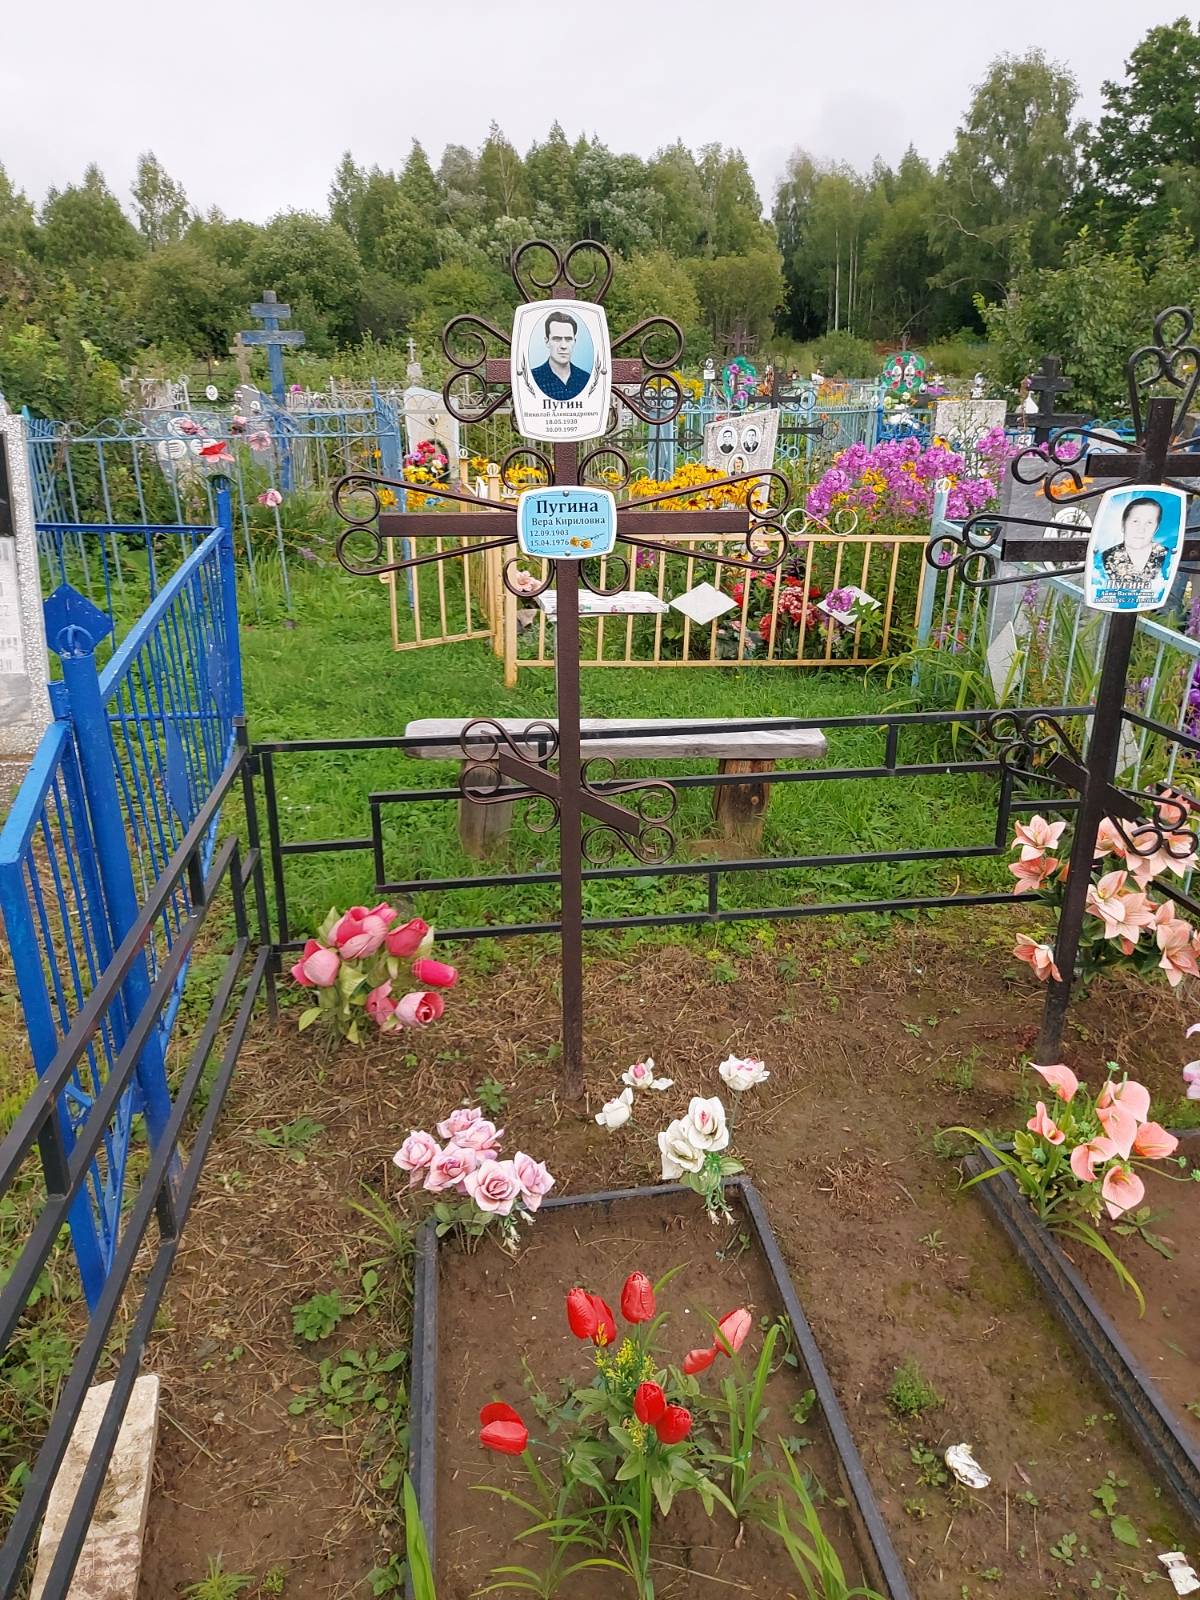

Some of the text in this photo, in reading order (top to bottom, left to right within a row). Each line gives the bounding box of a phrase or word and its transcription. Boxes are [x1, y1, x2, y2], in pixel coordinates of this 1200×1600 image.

[542, 398, 583, 411] Пугин
[536, 500, 599, 517] Пугина
[531, 517, 606, 527] Вера Кириловна
[529, 529, 569, 537] 12.09.1903
[530, 539, 569, 547] 15.04.1976
[1106, 578, 1152, 591] Пугина
